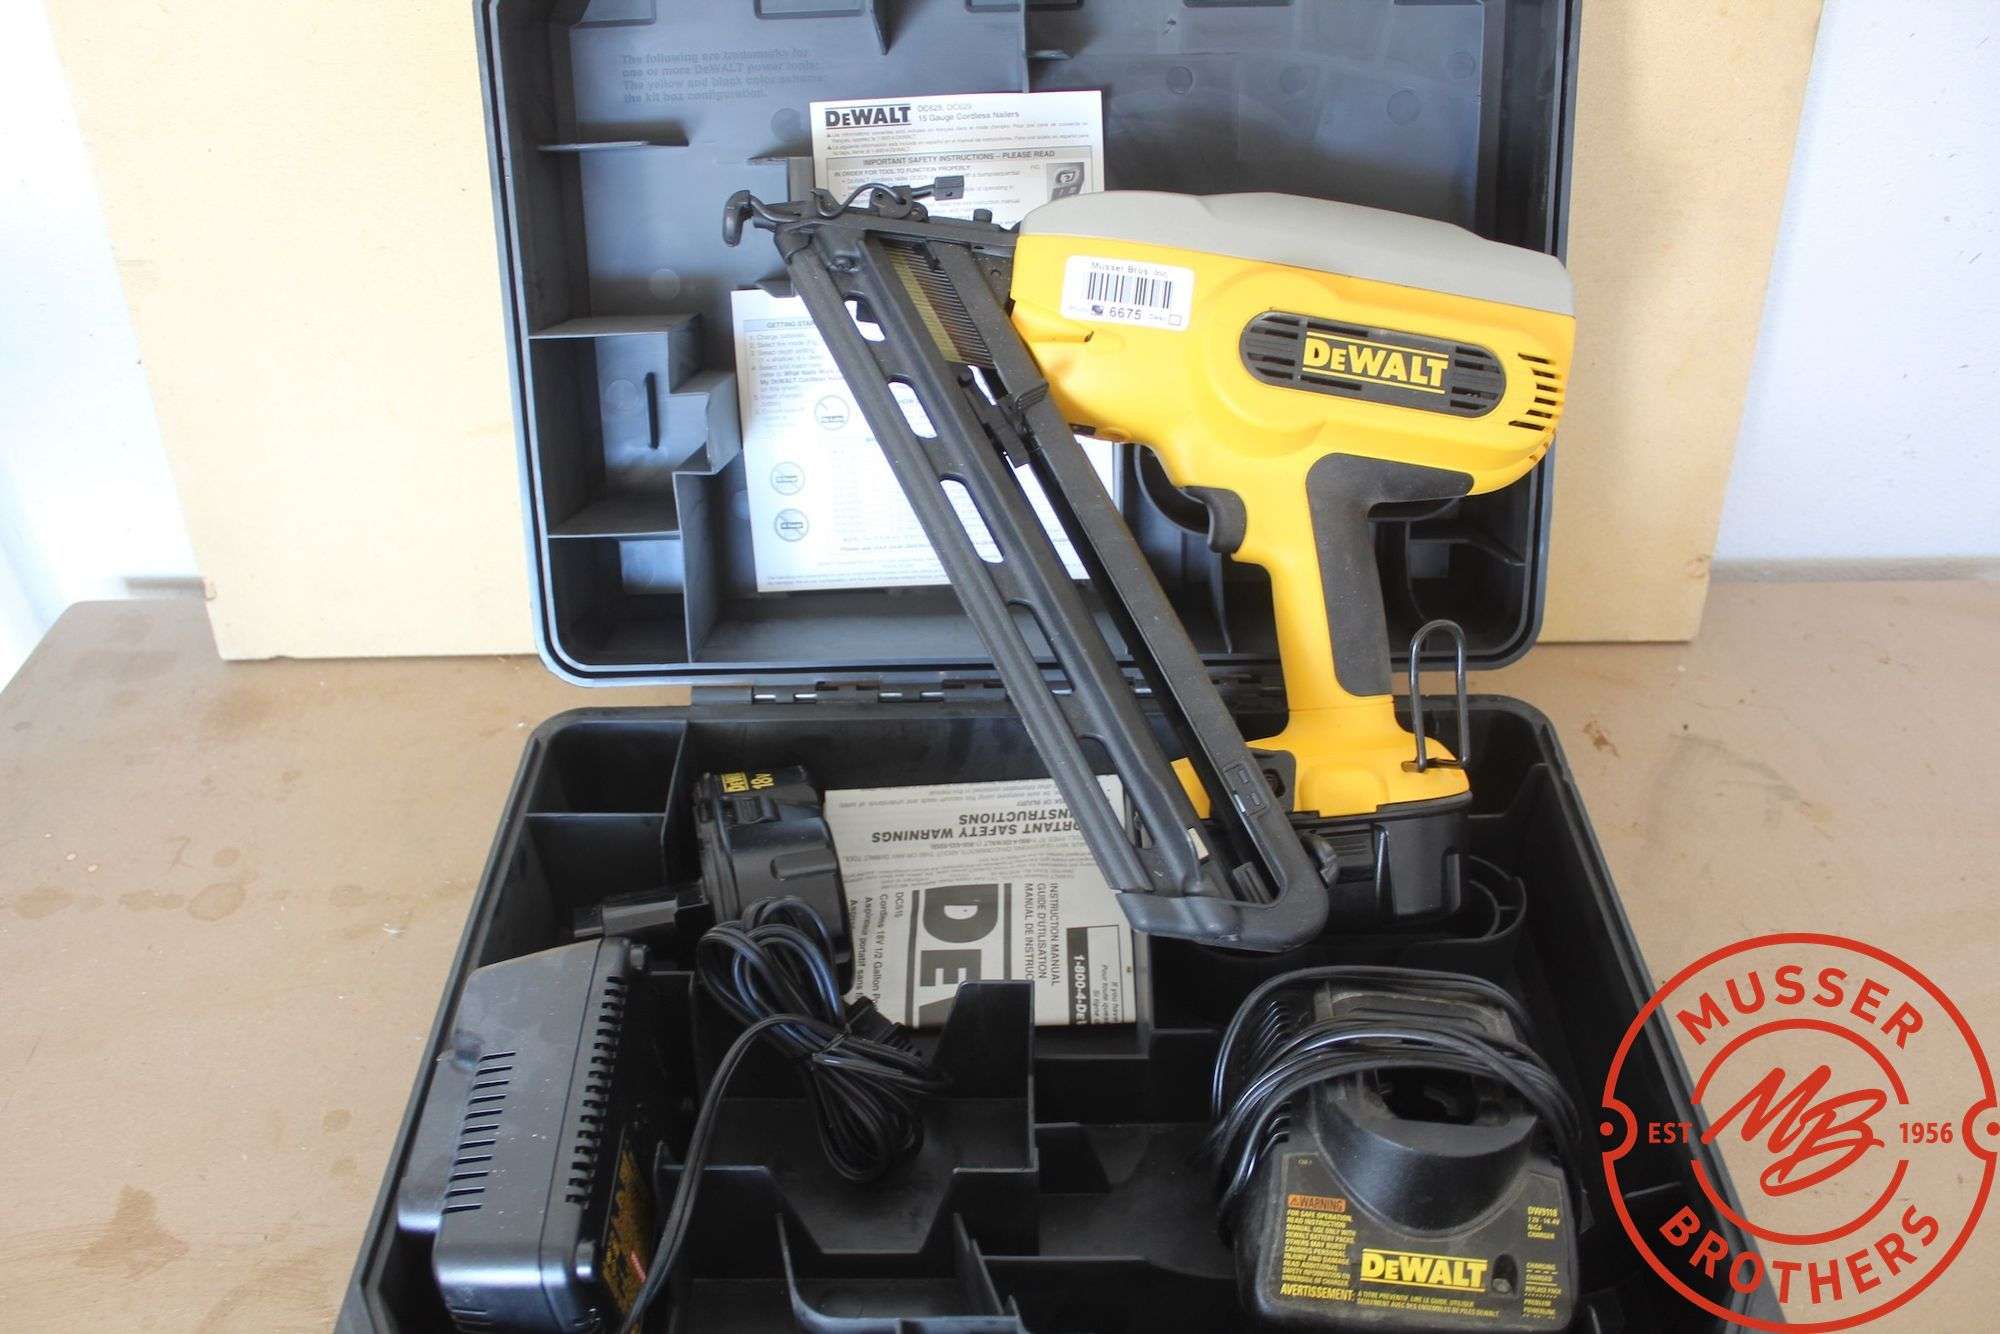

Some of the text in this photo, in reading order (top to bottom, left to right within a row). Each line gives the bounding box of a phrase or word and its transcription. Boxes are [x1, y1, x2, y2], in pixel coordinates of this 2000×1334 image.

[956, 112, 991, 121] Cordless
[992, 111, 1020, 119] Nailers
[863, 157, 907, 166] IMPORTANT
[908, 155, 937, 165] SAFETY
[939, 153, 995, 163] INSTRUCTIONS
[1002, 151, 1032, 159] PLEASE
[1034, 150, 1056, 158] READ
[1303, 337, 1449, 388] DeWALT
[871, 828, 953, 843] WARNINGS
[958, 824, 1017, 838] SAFETY
[877, 893, 888, 928] Cordless
[1024, 882, 1034, 921] MANUAL
[1024, 923, 1034, 933] DE
[1037, 882, 1047, 979] GUIDE D'UTILISATION
[1050, 882, 1060, 986] INSTRUCTION MANUAL
[858, 938, 867, 967] portatif
[874, 948, 883, 959] 1/2
[856, 969, 864, 994] sans
[872, 961, 883, 991] Gallon
[1300, 1197, 1344, 1211] WARNING
[1301, 1210, 1315, 1218] SAFE
[1362, 1253, 1488, 1288] DeWALT
[1280, 1283, 1356, 1301] AVERTISSEMENT:
